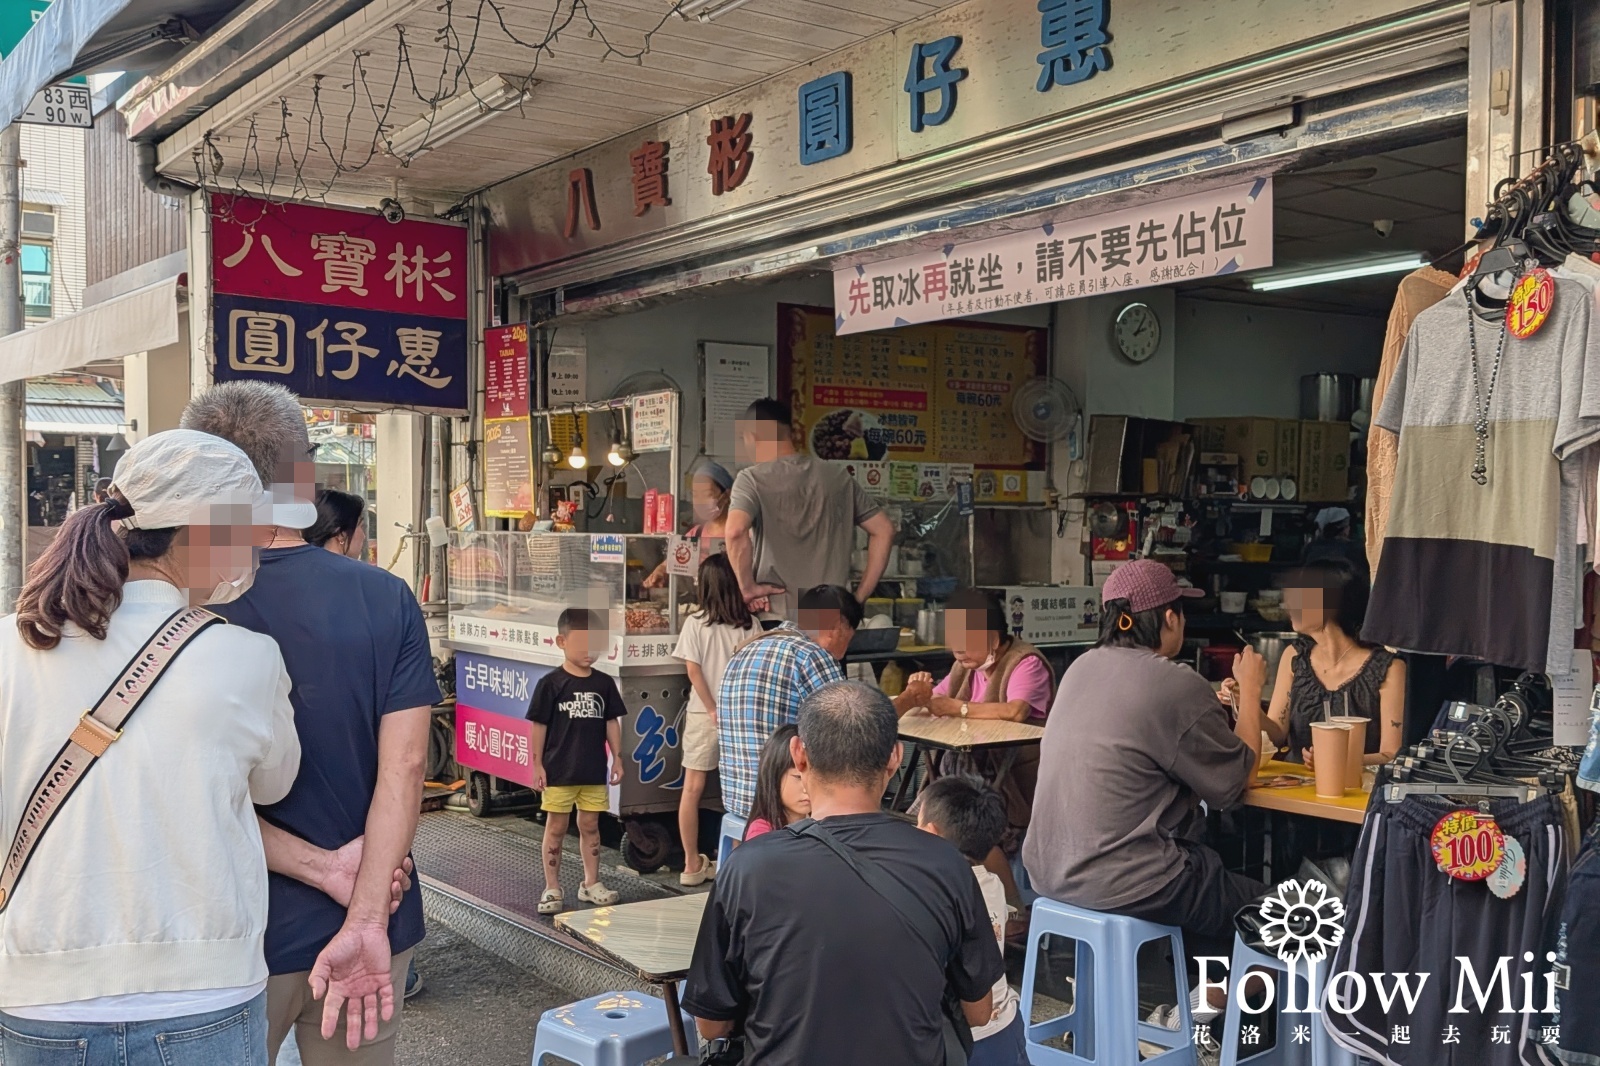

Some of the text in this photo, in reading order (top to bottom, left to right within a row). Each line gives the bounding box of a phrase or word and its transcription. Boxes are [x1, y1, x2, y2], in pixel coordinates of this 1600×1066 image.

[44, 88, 88, 111] 83 西
[45, 106, 66, 123] 90
[222, 231, 457, 302] 八寶彬
[1512, 274, 1536, 307] 特價
[1515, 280, 1550, 336] 150
[511, 325, 528, 343] 2026
[228, 308, 453, 390] 圓仔惠
[486, 424, 502, 443] 2025
[867, 427, 927, 445] 每碗60元
[459, 623, 539, 647] 排隊方向 先排隊點餐
[116, 652, 160, 705] LOUIS
[464, 660, 529, 702] 古早味剉冰
[558, 700, 594, 712] NORTH
[573, 691, 594, 701] THE
[569, 708, 594, 719] FACE
[464, 721, 530, 767] 暖心圓仔湯
[27, 757, 77, 829] VUITTON
[1442, 816, 1478, 835] 特價
[9, 828, 32, 877] LOUIS
[1445, 830, 1495, 871] 100
